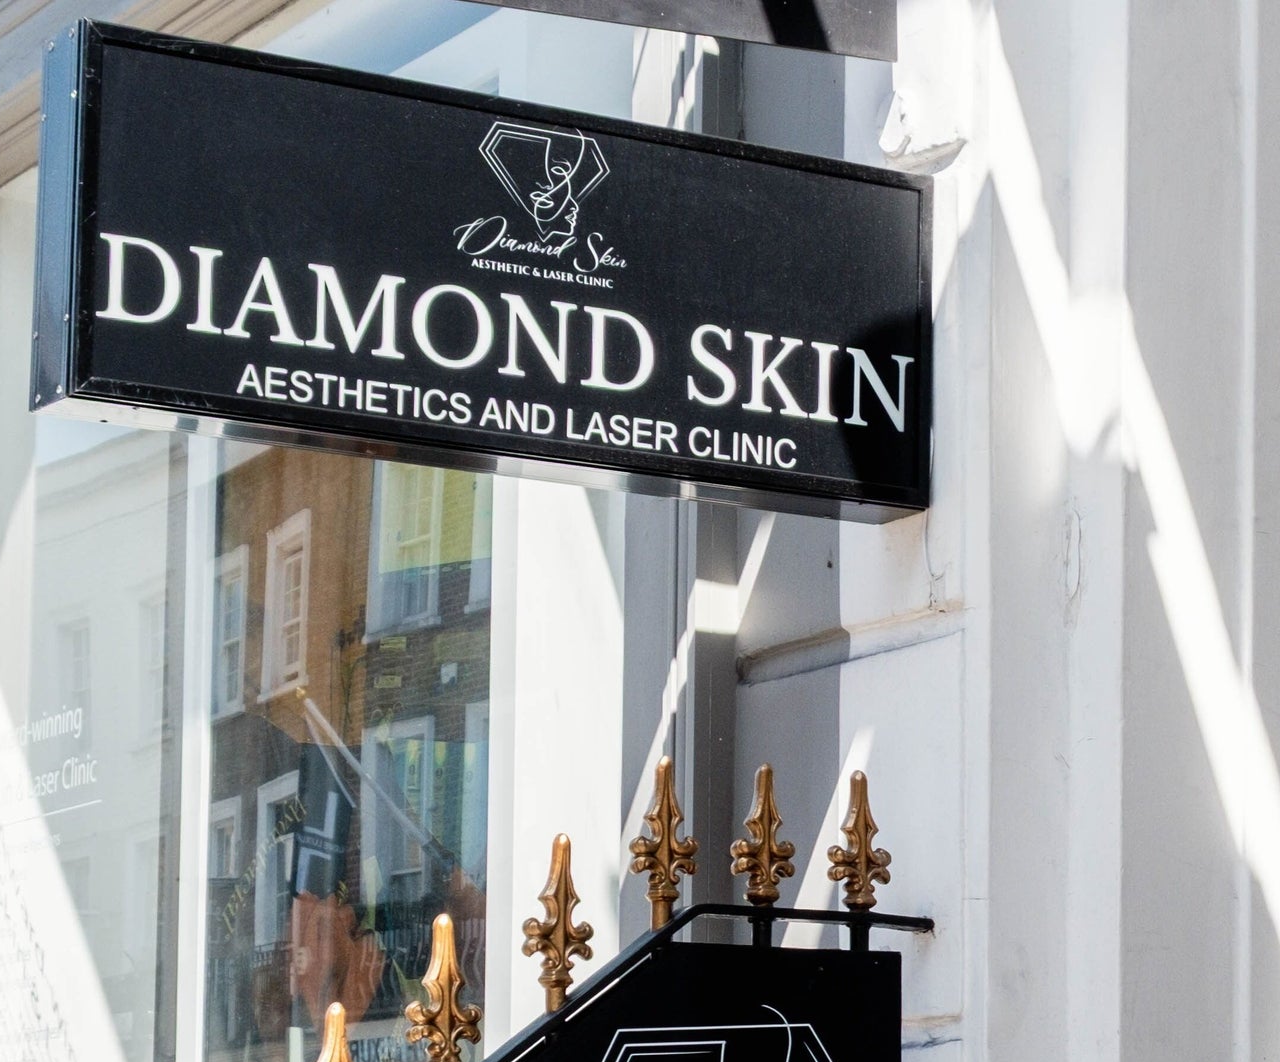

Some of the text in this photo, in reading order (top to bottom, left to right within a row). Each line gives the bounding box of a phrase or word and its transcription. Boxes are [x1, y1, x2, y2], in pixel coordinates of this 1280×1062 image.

[453, 216, 628, 272] Diamond Skin
[471, 258, 614, 289] AESTHETIC & LASER CLINIC
[95, 231, 915, 433] DIAMOND SKIN
[236, 364, 797, 469] AESTHETICS AND LASER CLINIC
[62, 753, 98, 791] Clinic
